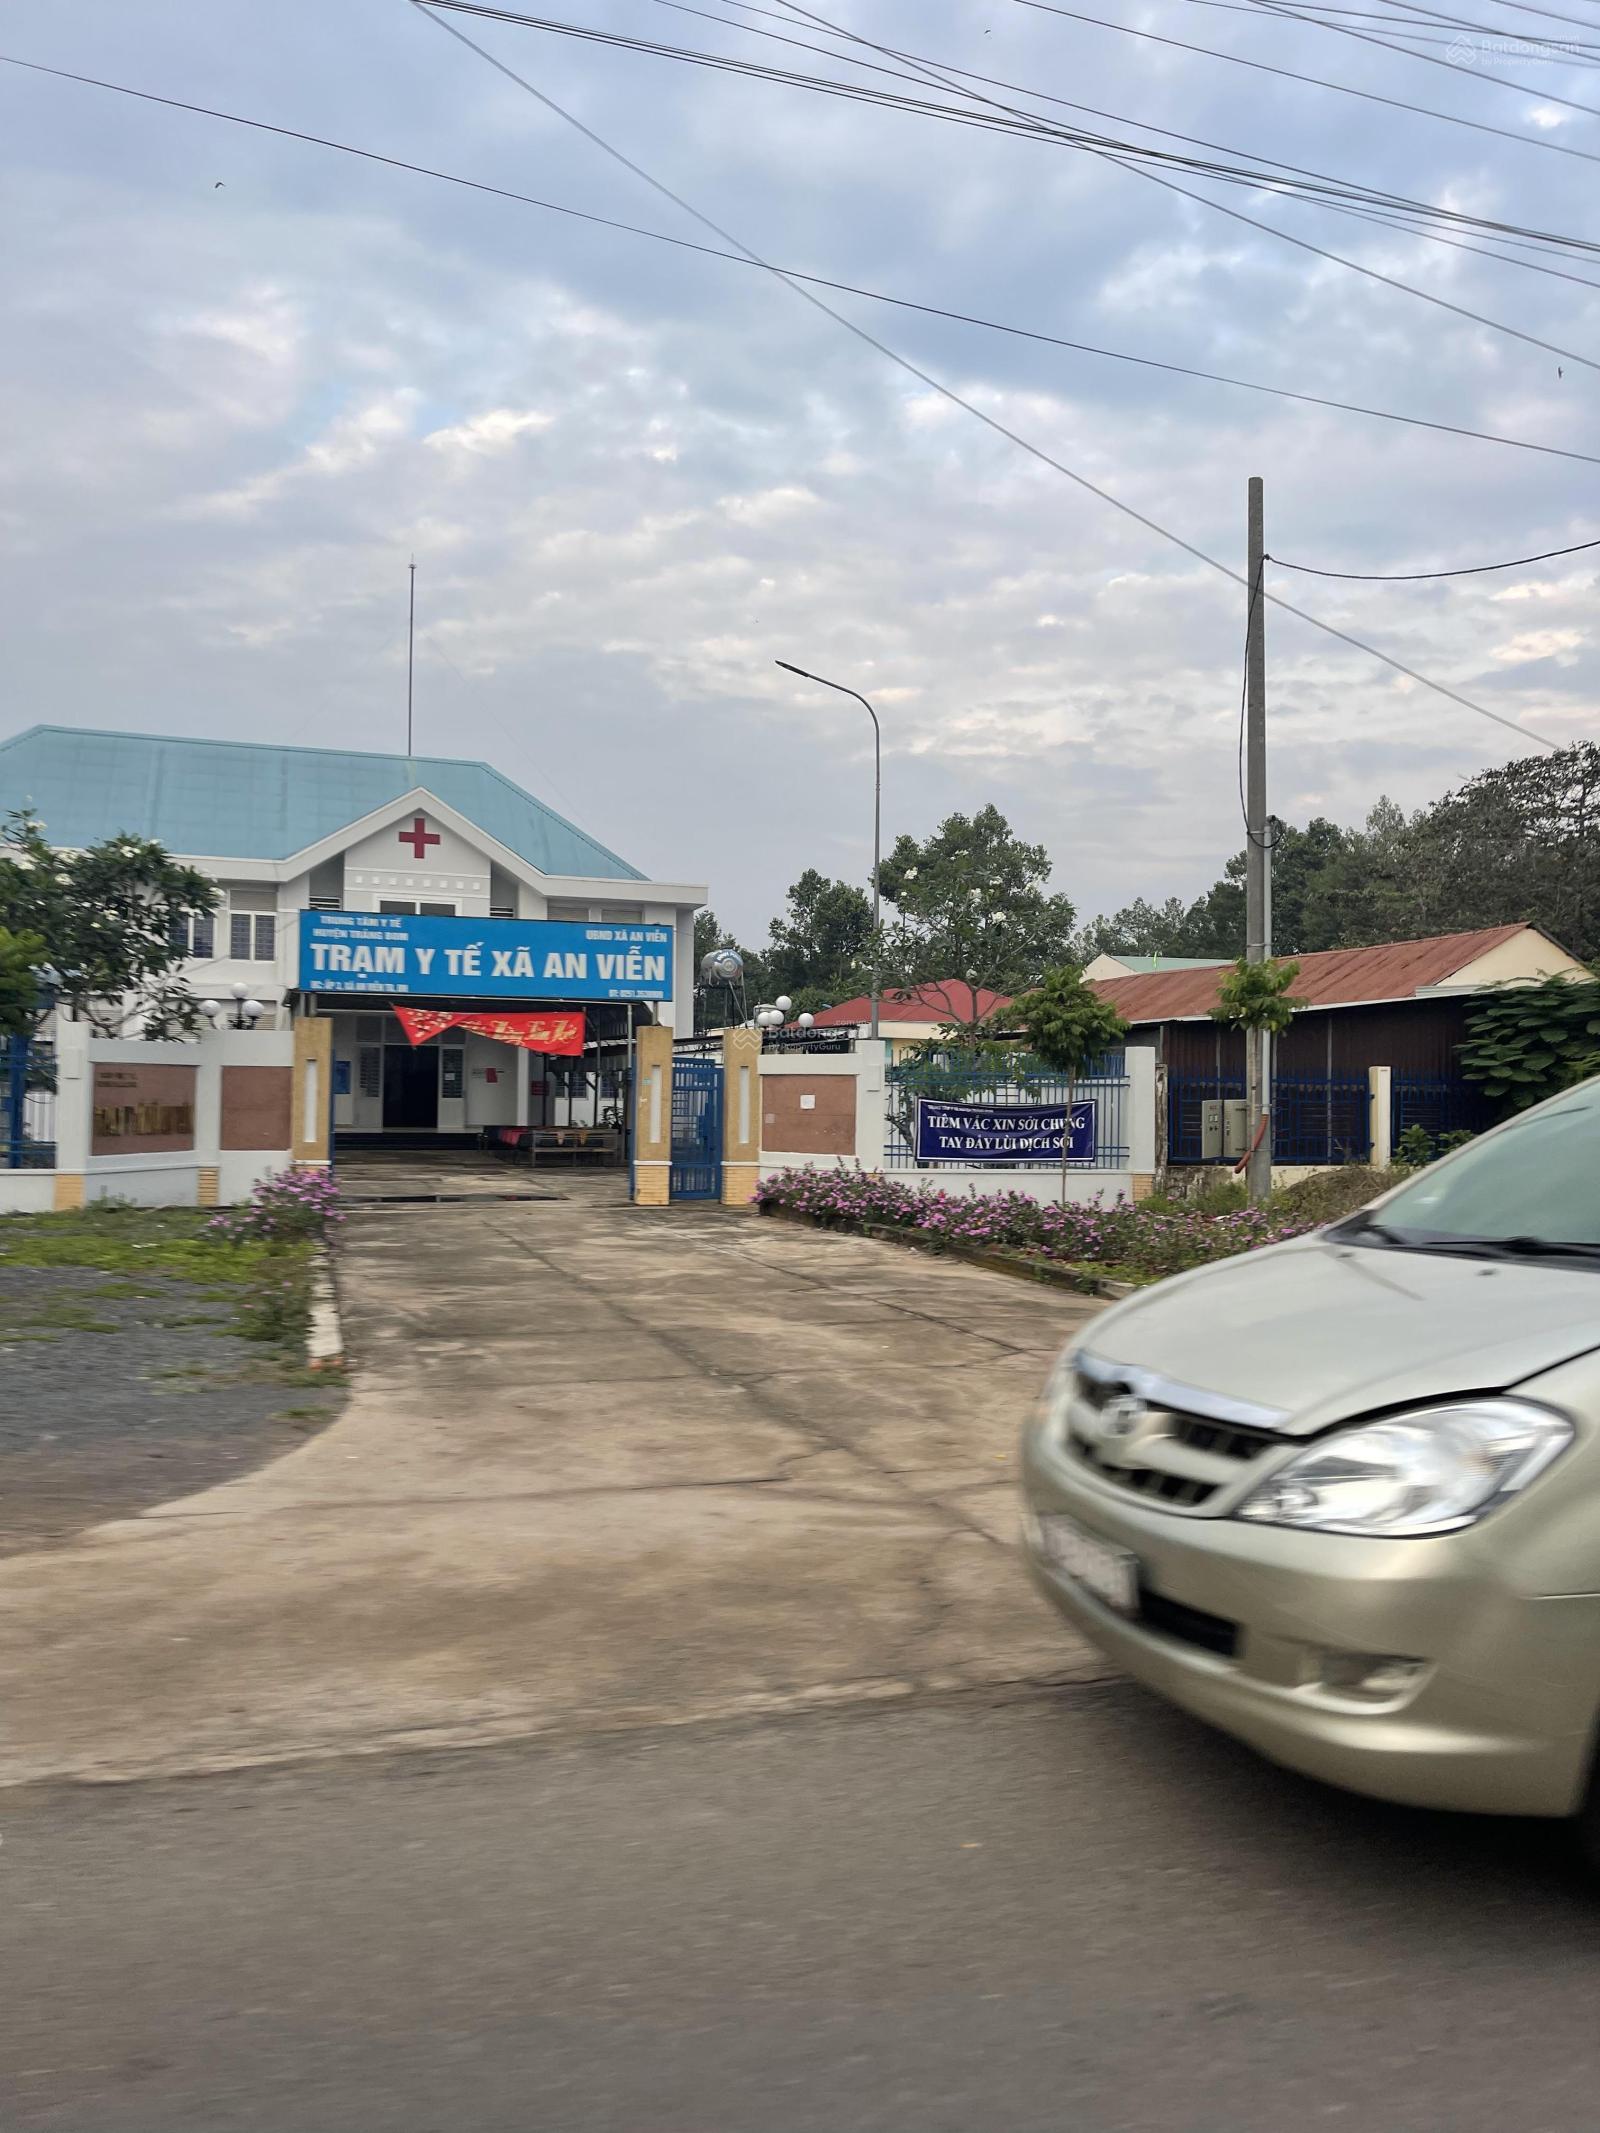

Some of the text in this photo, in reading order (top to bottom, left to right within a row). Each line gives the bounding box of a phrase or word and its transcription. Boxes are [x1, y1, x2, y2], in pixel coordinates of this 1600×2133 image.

[630, 931, 643, 942] AN
[309, 941, 666, 981] TRẠM Y TẾ XÃ AN VIỄN
[927, 1113, 961, 1129] TIÊM
[992, 1119, 1017, 1131] XIN
[938, 1136, 964, 1149] TAY
[994, 1134, 1017, 1150] LÙI
[1019, 1137, 1051, 1152] DỊCH
